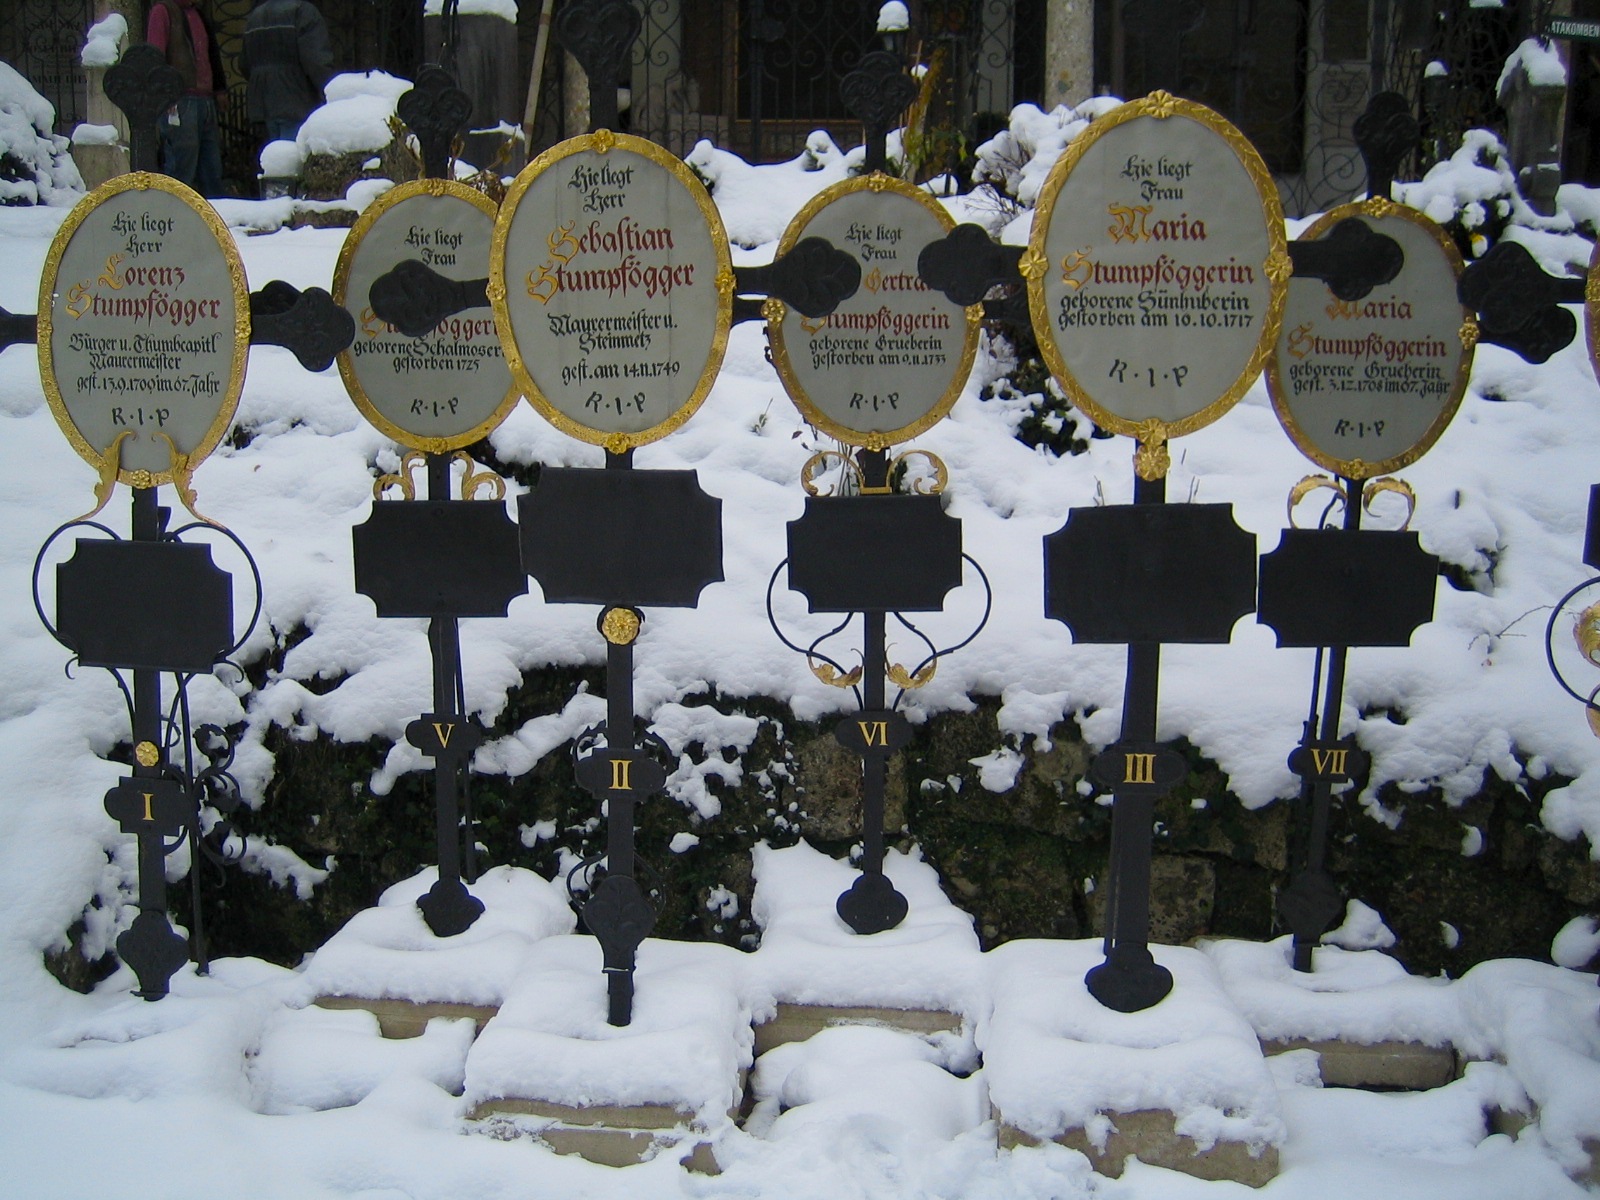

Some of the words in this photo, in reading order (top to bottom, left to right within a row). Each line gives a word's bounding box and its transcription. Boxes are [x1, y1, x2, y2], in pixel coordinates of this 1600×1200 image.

[1545, 21, 1600, 37] ATAKOMBEN
[567, 165, 600, 193] Hie
[600, 160, 635, 189] liegt
[1121, 154, 1153, 181] Hie
[1157, 158, 1194, 182] liegt
[583, 191, 626, 215] Herr
[1140, 180, 1184, 202] Frau
[111, 211, 137, 235] Hie
[141, 214, 175, 236] liegt
[844, 222, 871, 245] Hie
[876, 223, 903, 246] liegt
[1107, 202, 1208, 245] Maria
[125, 235, 162, 258] Herr
[404, 225, 431, 248] Hie
[435, 229, 463, 251] liegt
[546, 216, 675, 265] Sebastian
[421, 247, 457, 266] Frau
[861, 244, 897, 262] Frau
[97, 253, 185, 291] Lorenz
[526, 255, 695, 305] Stumpfögger
[1059, 244, 1255, 292] Stumpföggerin
[65, 280, 221, 326] Stumpfögger
[1060, 287, 1133, 312] geborene
[1058, 308, 1136, 332] gestorben
[1141, 311, 1168, 328] am
[68, 332, 118, 353] Bürger
[353, 339, 413, 357] geborene
[809, 335, 869, 355] geborene
[1287, 321, 1447, 362] Stumpföggerin
[393, 354, 454, 374] gestorben
[457, 359, 480, 374] 1725
[812, 349, 874, 371] gestorben
[879, 353, 900, 365] am
[1290, 360, 1354, 380] geborene
[432, 723, 455, 748] V
[858, 722, 888, 746] VI
[609, 759, 632, 790] II
[1123, 753, 1156, 784] III
[1311, 749, 1348, 775] VII
[142, 793, 154, 820] I
